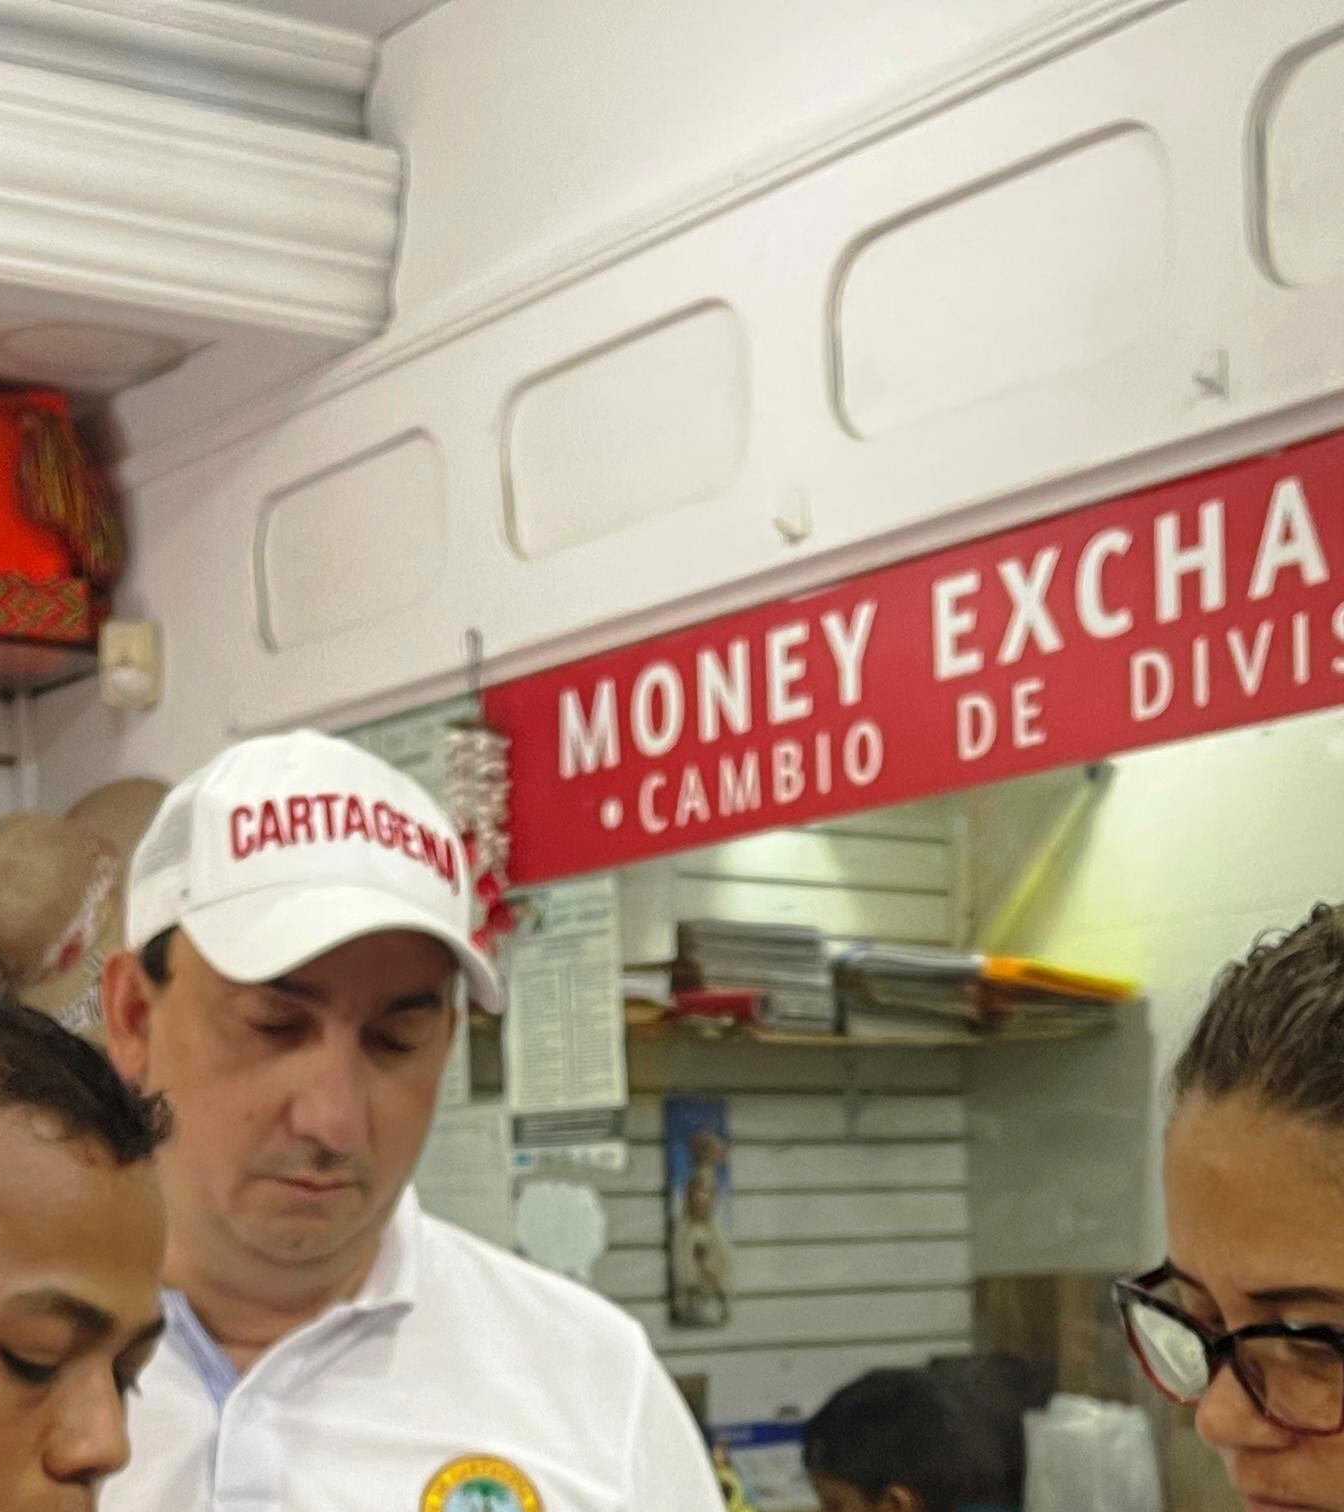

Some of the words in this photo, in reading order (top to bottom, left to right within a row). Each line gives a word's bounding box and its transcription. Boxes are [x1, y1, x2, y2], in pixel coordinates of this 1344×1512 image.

[558, 600, 878, 779] MONEY
[636, 719, 885, 834] CAMBIO
[957, 678, 1047, 762] DE
